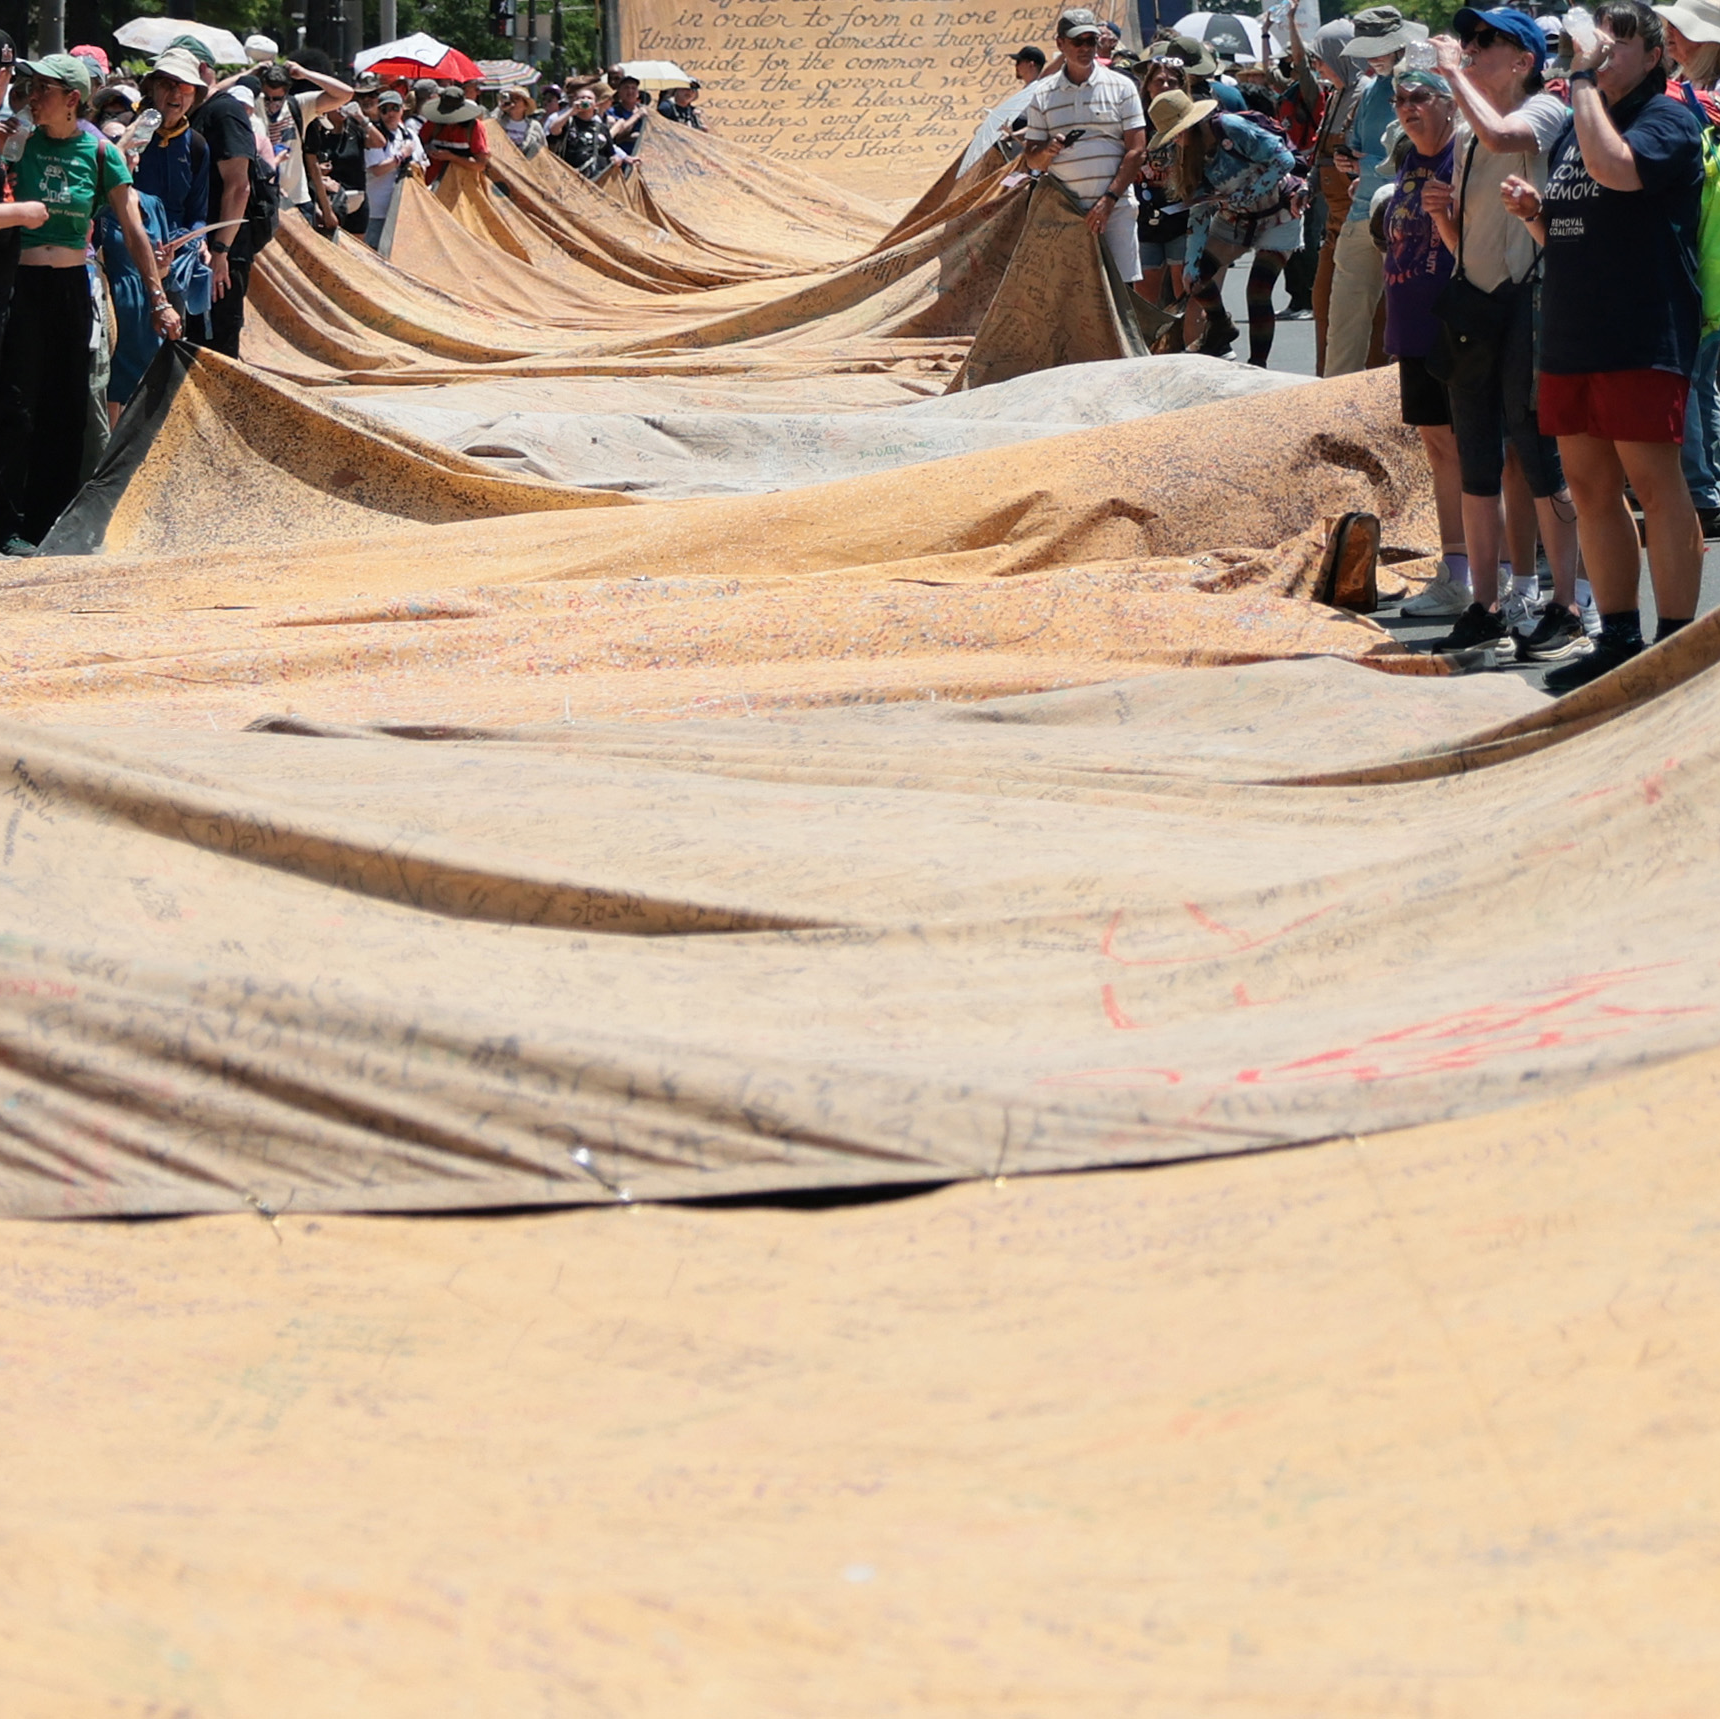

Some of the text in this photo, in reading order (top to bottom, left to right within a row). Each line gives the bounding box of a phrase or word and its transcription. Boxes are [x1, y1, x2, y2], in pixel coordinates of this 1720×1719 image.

[671, 9, 705, 28] in
[712, 5, 797, 28] order
[802, 5, 834, 28] to
[838, 5, 901, 35] form
[910, 13, 931, 28] a
[933, 9, 998, 28] more
[721, 32, 808, 51] insure
[815, 29, 924, 50] domestic
[751, 51, 795, 78] for
[797, 51, 835, 72] the
[844, 55, 938, 70] common
[760, 72, 807, 92] the
[815, 72, 924, 96] general
[698, 96, 791, 111] secure
[796, 89, 842, 110] the
[851, 89, 970, 112] blessings
[821, 109, 871, 126] and
[874, 112, 913, 124] our
[734, 127, 784, 144] and
[792, 122, 903, 143] establish
[915, 123, 959, 138] this
[845, 140, 925, 159] States
[935, 140, 968, 158] of
[1544, 181, 1600, 200] REMOVE
[1548, 226, 1585, 237] COALITION
[1550, 217, 1584, 228] REMOVAL
